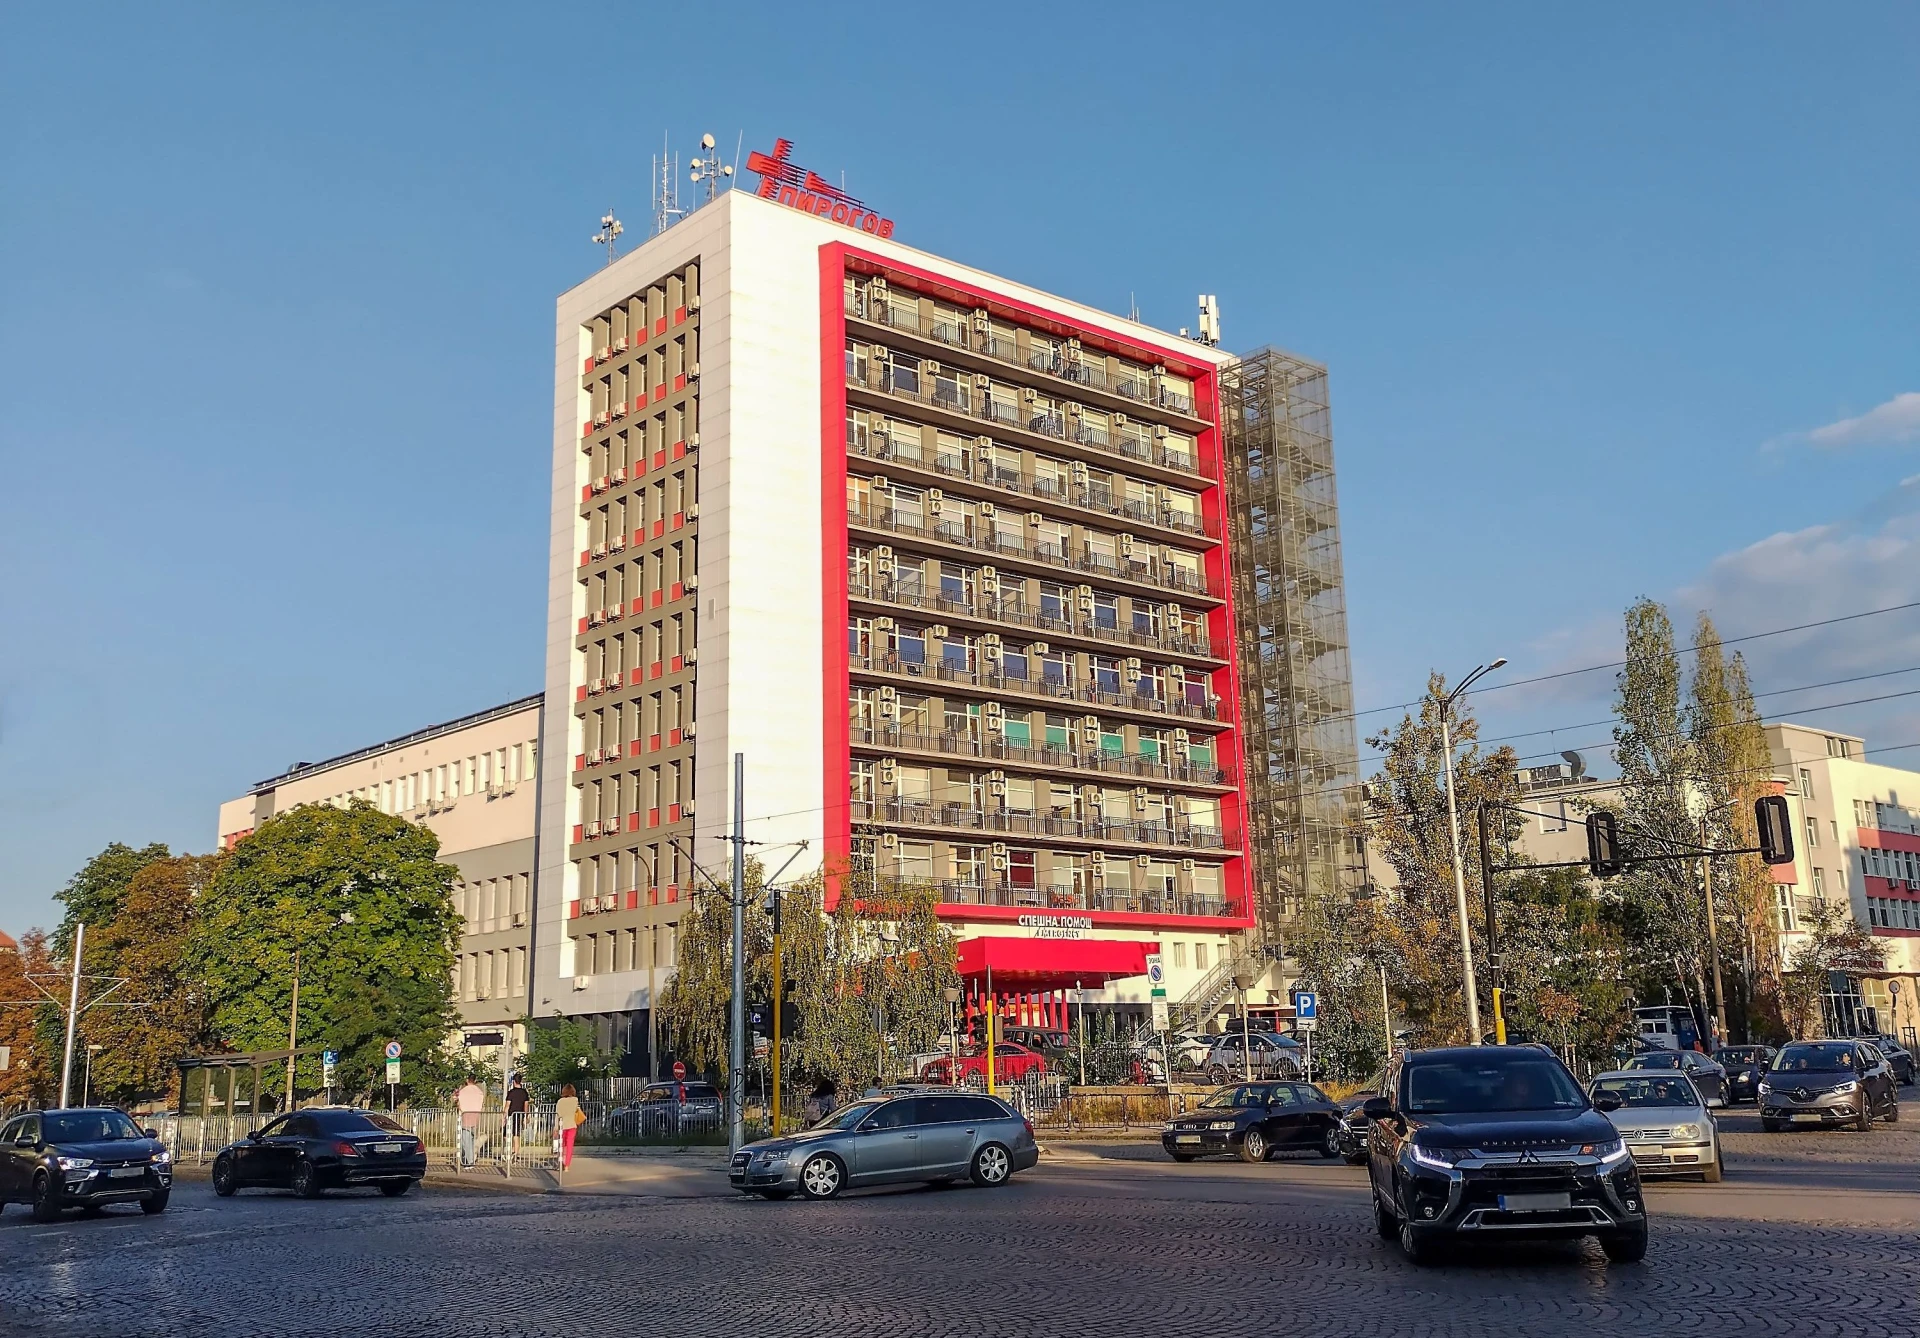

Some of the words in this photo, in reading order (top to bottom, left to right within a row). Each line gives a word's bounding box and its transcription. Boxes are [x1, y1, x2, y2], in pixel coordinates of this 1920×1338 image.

[778, 185, 894, 239] ПИРОГОВ
[1018, 915, 1058, 927] СПЕШНА
[1060, 916, 1092, 929] ПОМОЩ
[1300, 995, 1311, 1015] P
